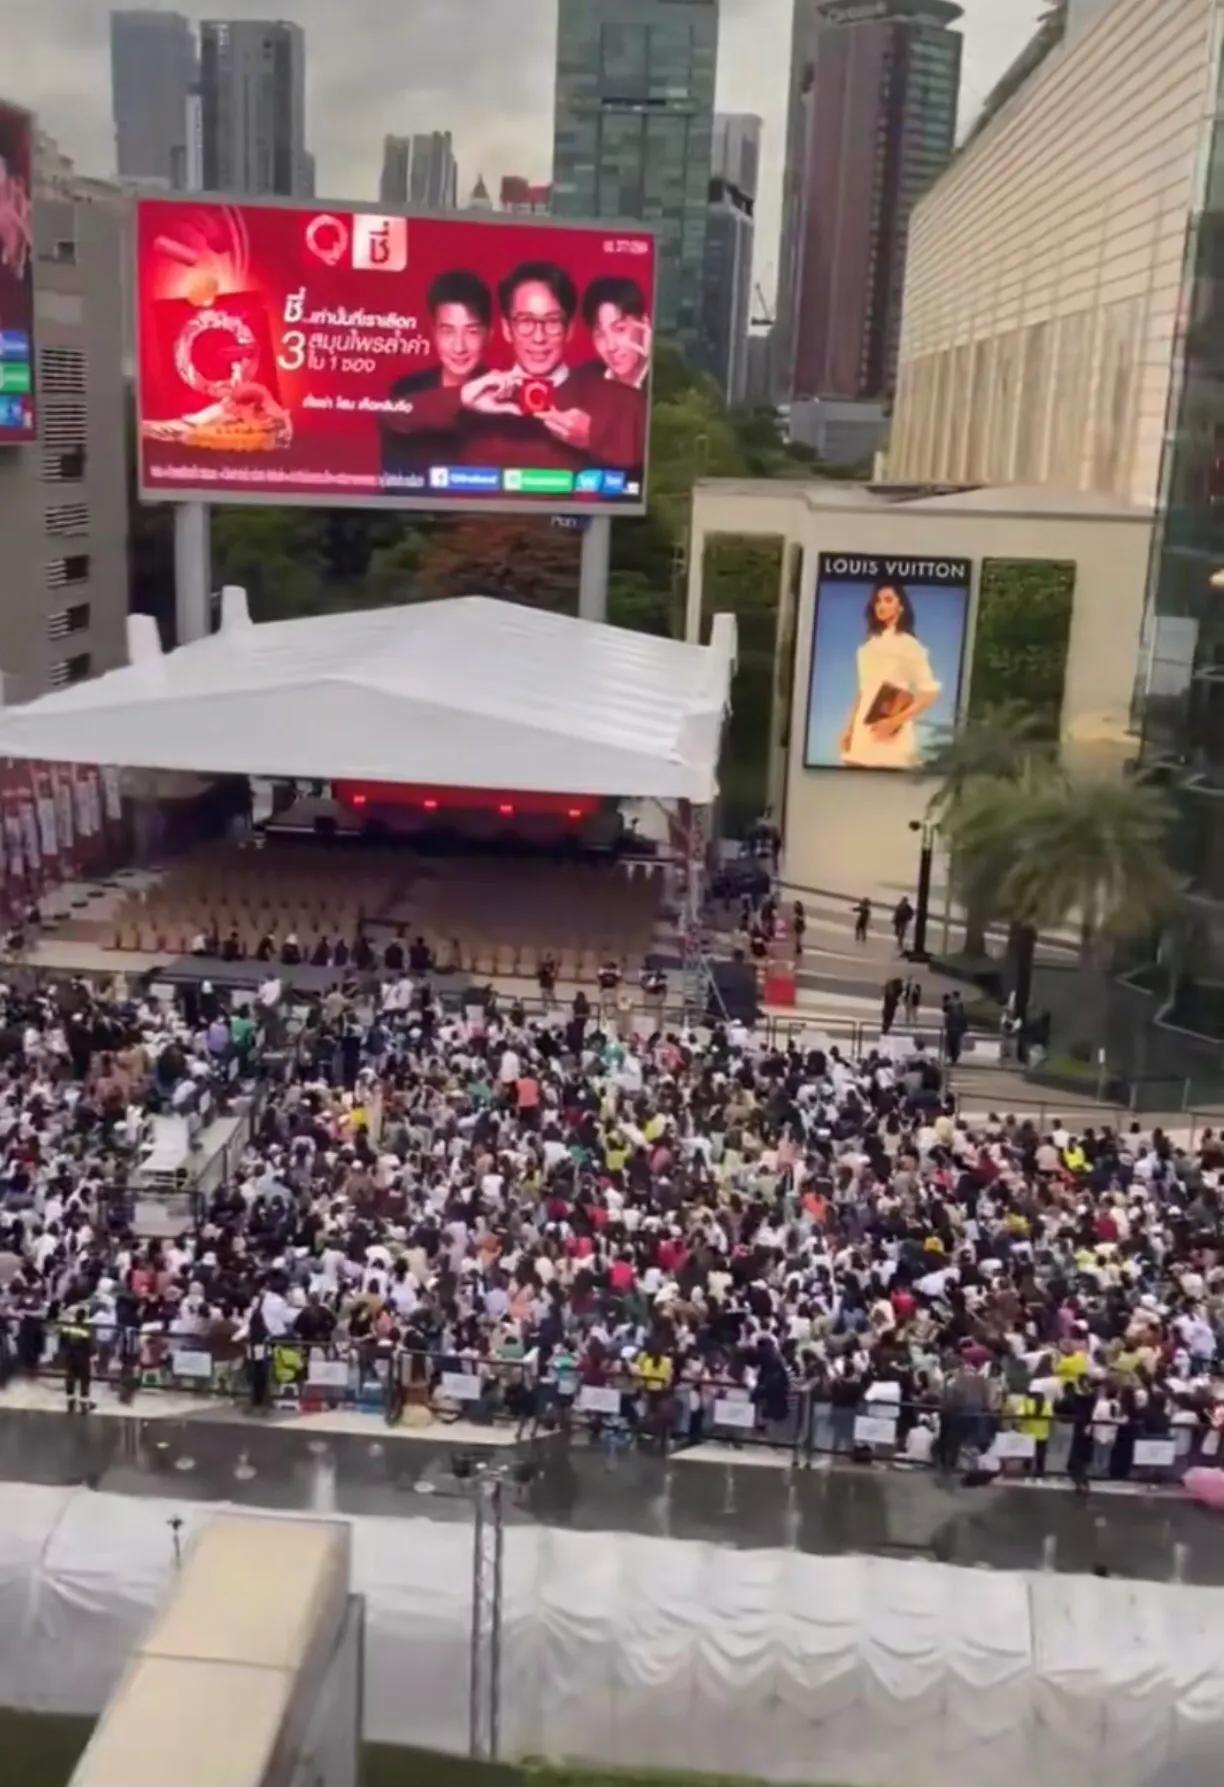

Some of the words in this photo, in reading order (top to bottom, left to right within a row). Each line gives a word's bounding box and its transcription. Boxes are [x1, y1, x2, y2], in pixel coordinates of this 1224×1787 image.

[277, 330, 306, 371] 3
[825, 559, 878, 575] LOUIS
[885, 561, 965, 578] VUITTON
